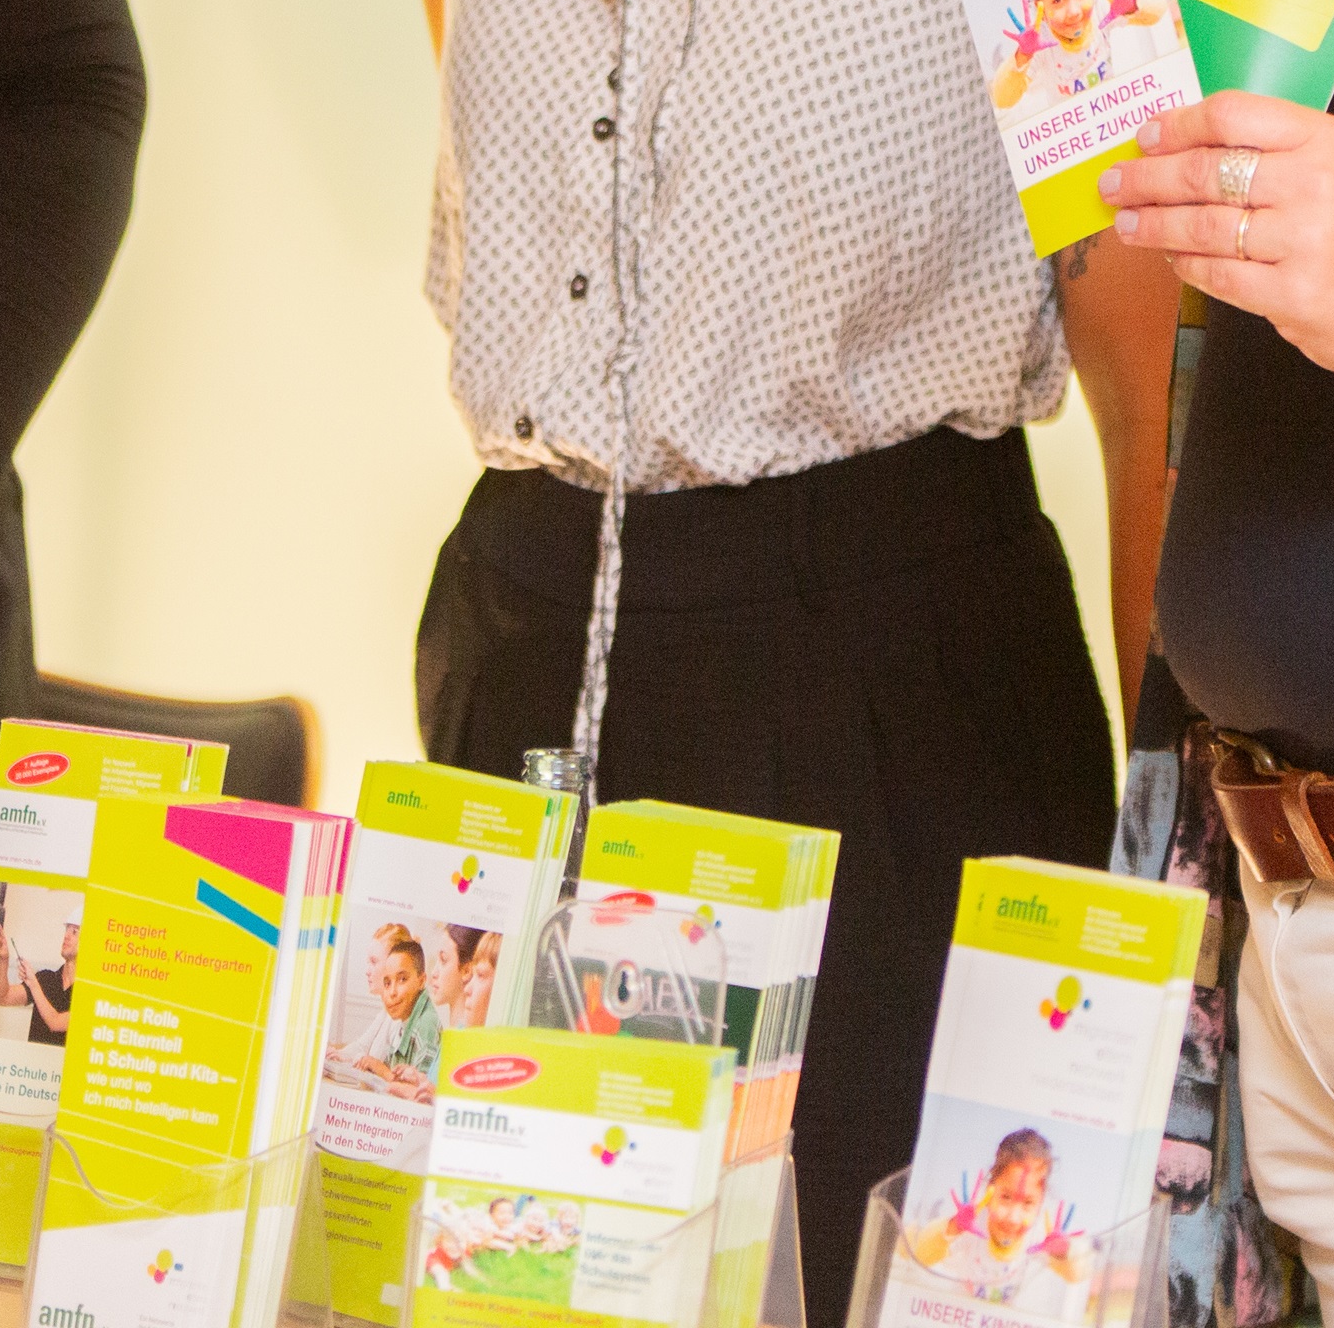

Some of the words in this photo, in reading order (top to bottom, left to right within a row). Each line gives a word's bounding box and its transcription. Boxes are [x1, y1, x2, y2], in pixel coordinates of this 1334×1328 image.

[1017, 105, 1087, 150] UNSERE
[1089, 74, 1162, 117] KINDER,
[1025, 131, 1094, 175] UNSERE
[1097, 90, 1185, 142] ZUKUNFT!
[387, 790, 421, 810] amfn
[0, 804, 38, 826] amfn
[602, 839, 636, 858] amfn
[997, 895, 1048, 925] amfn
[107, 918, 167, 941] Engagiert
[105, 939, 122, 954] für
[126, 942, 170, 963] Schule,
[174, 950, 253, 975] Kindergarten
[102, 962, 127, 976] und
[130, 964, 170, 982] Kinder
[95, 1000, 139, 1023] Meine
[142, 1007, 180, 1029] Rolle
[92, 1026, 115, 1044] als
[118, 1027, 183, 1054] Elternteil
[9, 1064, 48, 1082] Schule
[89, 1048, 104, 1065] in
[107, 1050, 157, 1074] Schule
[160, 1061, 188, 1079] und
[190, 1063, 219, 1085] Kita
[4, 1082, 15, 1095] in
[18, 1084, 61, 1102] Deutsc
[86, 1071, 107, 1087] wie
[110, 1074, 133, 1091] und
[134, 1080, 152, 1094] wo
[83, 1089, 102, 1106] ich
[104, 1093, 132, 1111] mich
[135, 1097, 189, 1122] beteiligen
[191, 1108, 219, 1126] kann
[328, 1096, 371, 1116] Unseren
[373, 1106, 409, 1126] Kindern
[445, 1106, 509, 1134] amfn
[321, 1132, 332, 1143] in
[334, 1135, 354, 1149] den
[325, 1114, 351, 1131] Mehr
[353, 1121, 404, 1142] Integration
[39, 1303, 95, 1328] amfn
[910, 1297, 976, 1328] UNSERE
